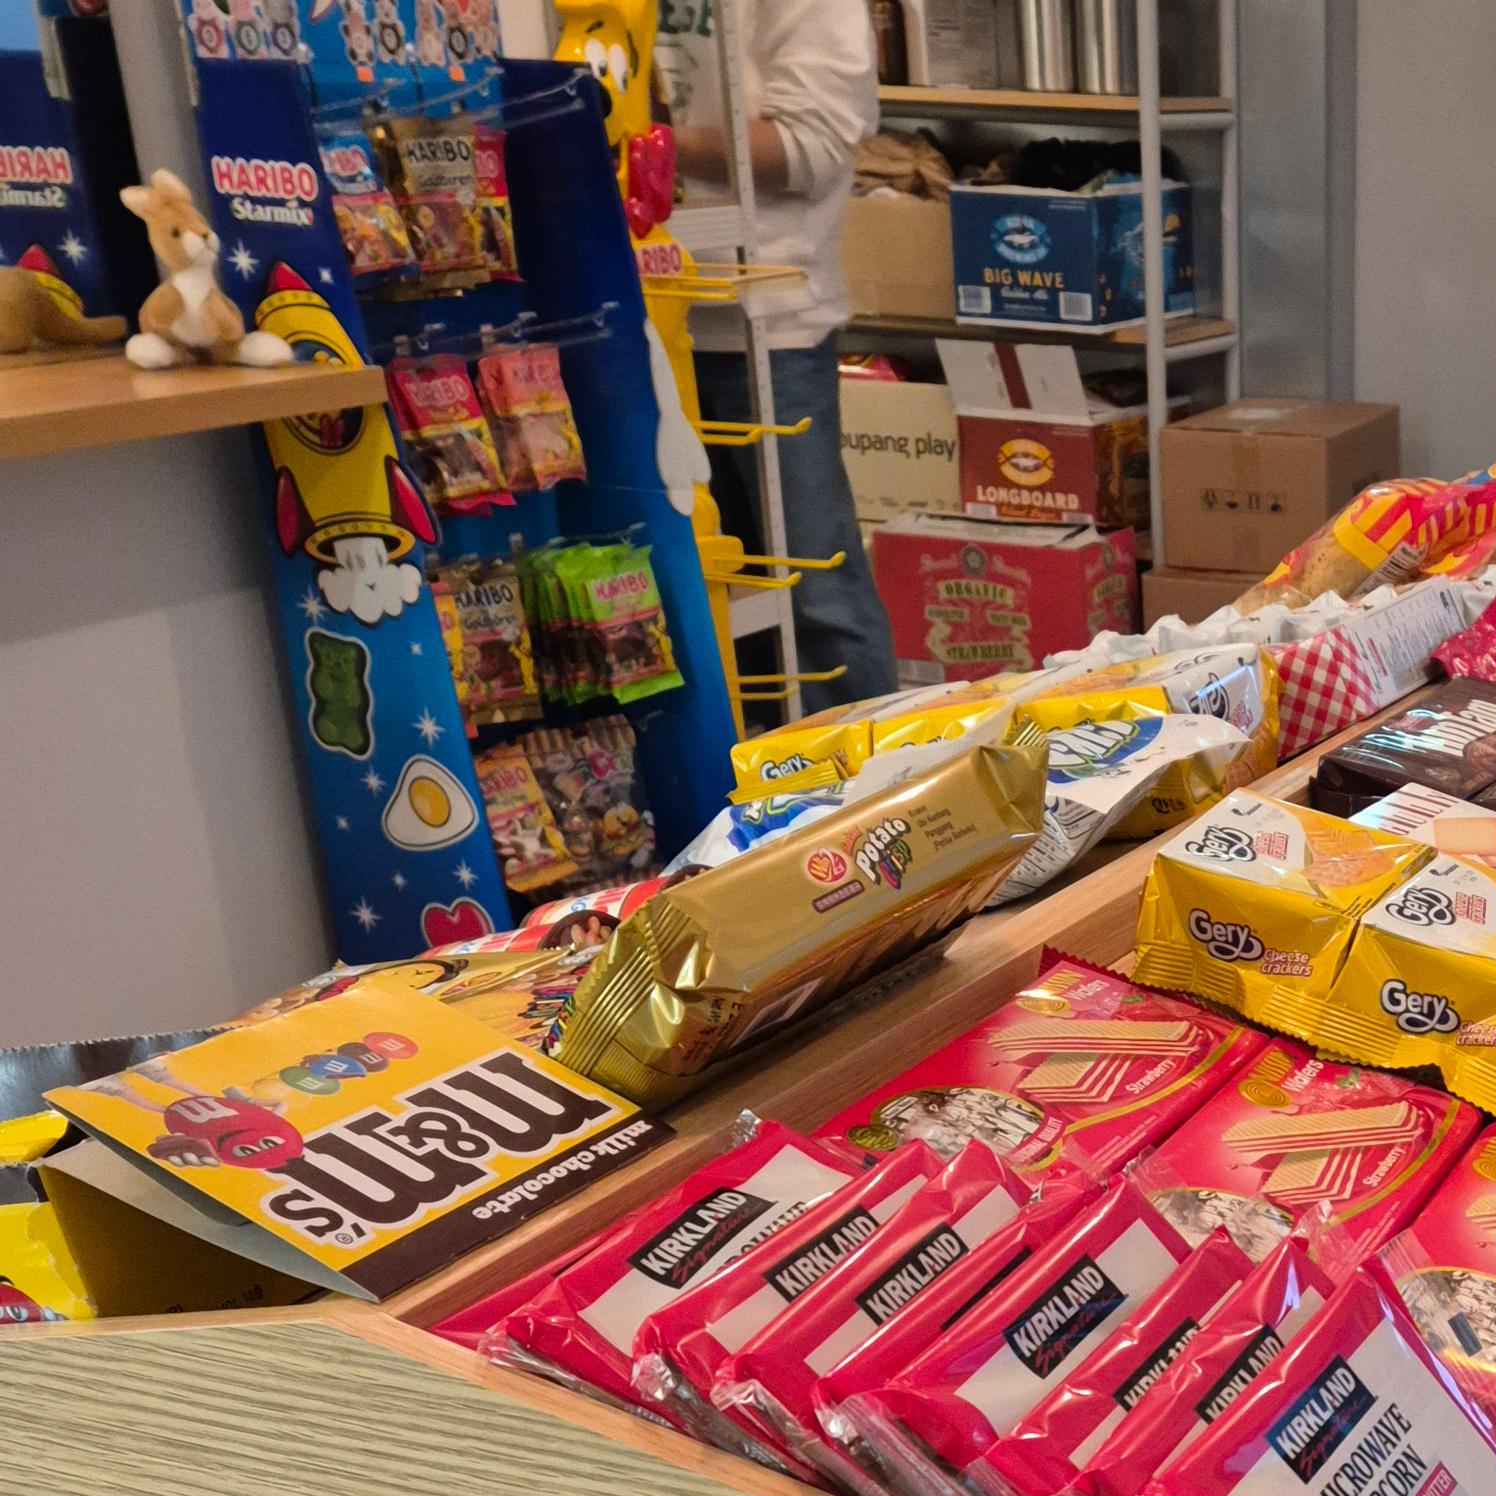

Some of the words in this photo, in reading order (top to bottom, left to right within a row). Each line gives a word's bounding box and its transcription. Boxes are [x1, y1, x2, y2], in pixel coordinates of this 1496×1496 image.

[404, 140, 470, 164] HARIBO
[212, 156, 317, 200] HARIBO
[231, 198, 311, 226] Starmix
[983, 267, 1013, 285] BIG
[1017, 269, 1065, 290] WAVE
[841, 432, 911, 460] oupang
[915, 431, 956, 463] play
[977, 485, 1080, 511] LONGBOARD
[455, 584, 514, 609] HARIBO
[856, 818, 912, 886] Potato
[1186, 824, 1257, 862] Gery
[1385, 887, 1457, 927] Gery
[1189, 909, 1265, 962] Gery
[1261, 961, 1313, 978] crackers
[1381, 979, 1461, 1035] Gery
[1125, 1058, 1177, 1096] Strawberry
[1281, 1057, 1325, 1093] Wafers
[268, 1050, 614, 1245] m&m's
[593, 1120, 655, 1168] milk
[471, 1148, 599, 1221] chocolate
[1362, 1145, 1407, 1188] Strawberry
[640, 1192, 747, 1277] KIRKLAND
[775, 1214, 879, 1298] KIRKLAND
[866, 1233, 962, 1323] KIRKLAND
[1013, 1265, 1106, 1358] KIRKLAND
[1276, 1367, 1357, 1461] KIRKLAND
